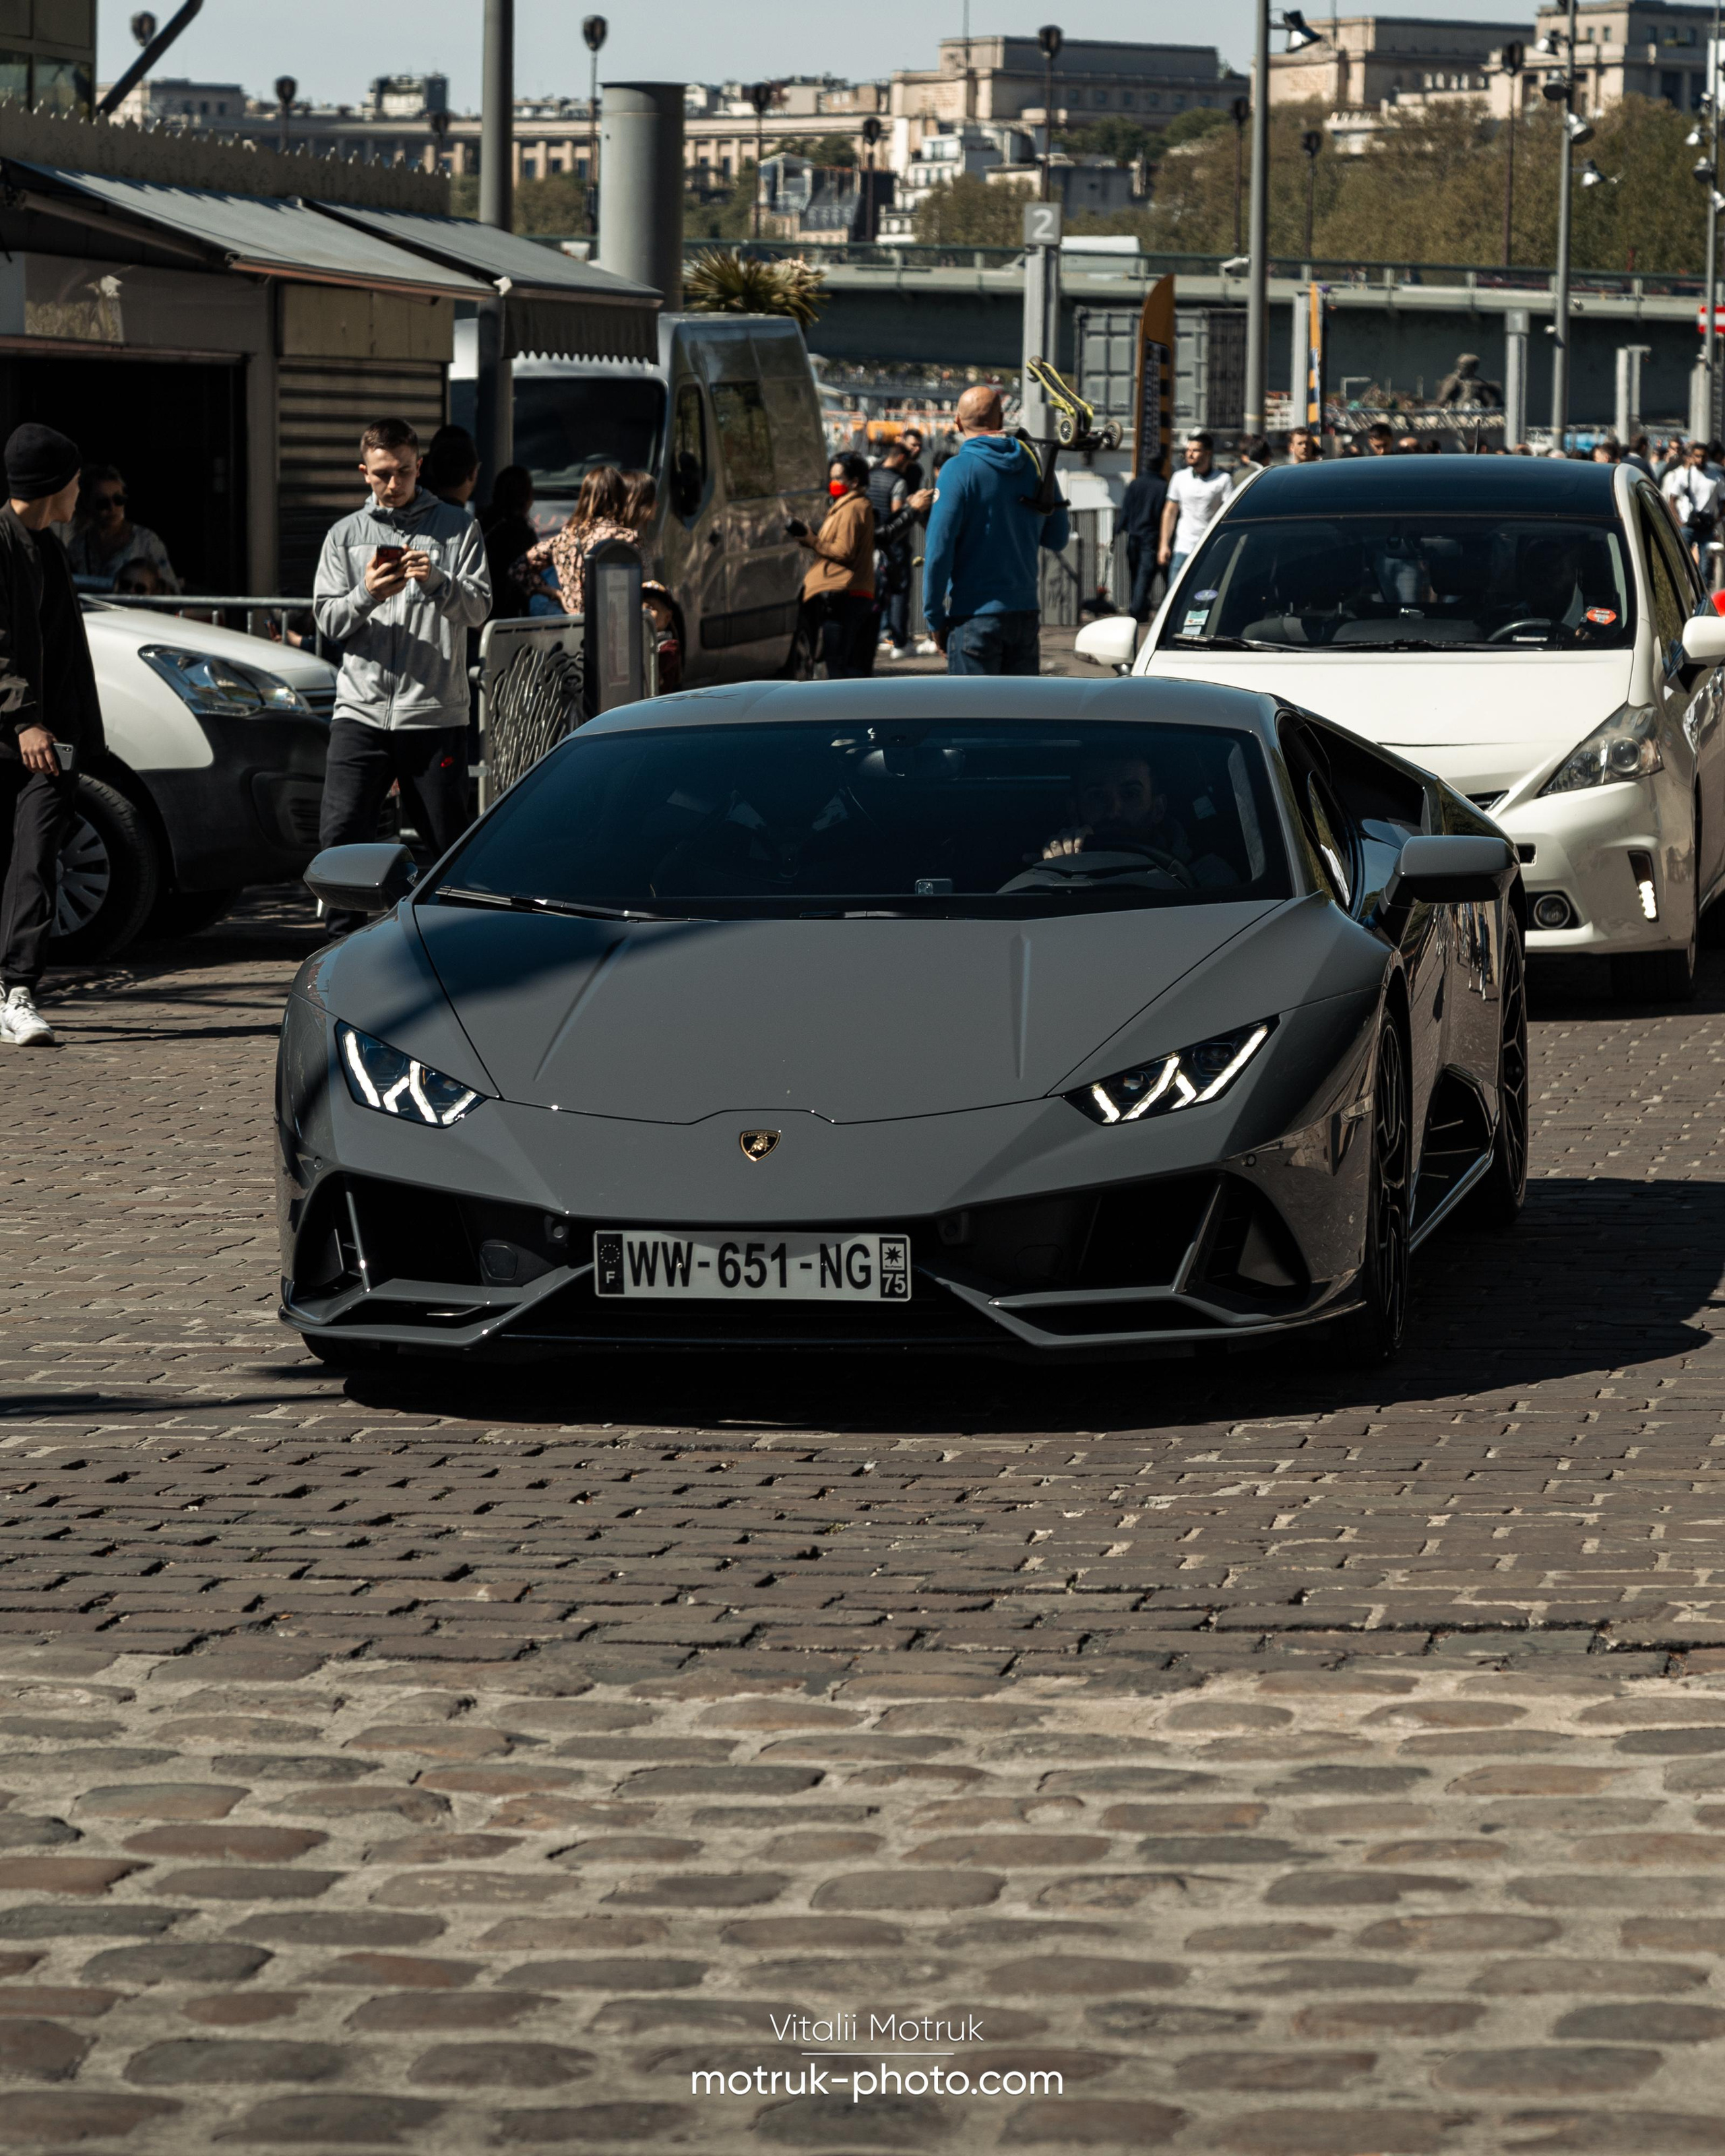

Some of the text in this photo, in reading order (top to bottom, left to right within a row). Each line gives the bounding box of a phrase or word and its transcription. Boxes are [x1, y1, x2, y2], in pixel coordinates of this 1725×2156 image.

[1032, 208, 1055, 240] 2
[606, 1271, 615, 1283] F
[627, 1240, 872, 1290] WW-651-NG
[882, 1273, 906, 1294] 75
